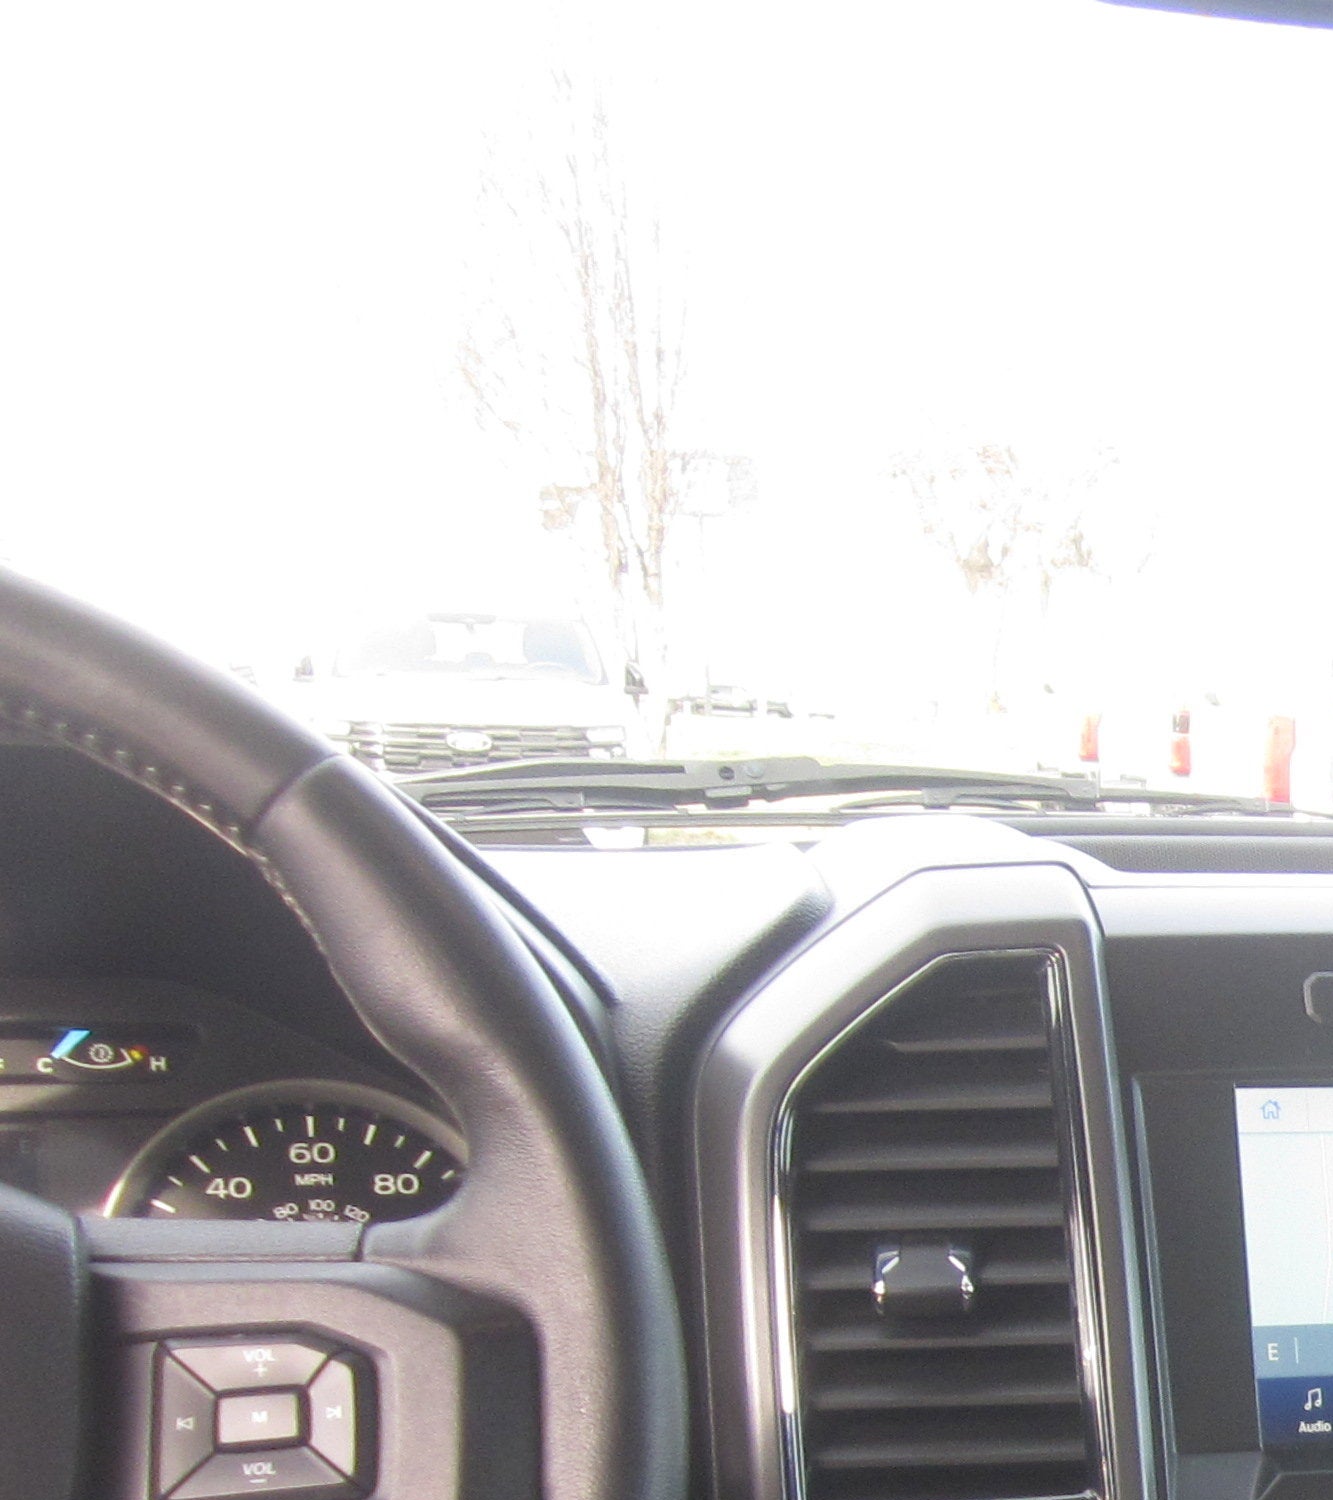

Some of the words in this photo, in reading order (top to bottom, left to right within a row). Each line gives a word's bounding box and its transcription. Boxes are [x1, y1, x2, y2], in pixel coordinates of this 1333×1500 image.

[36, 1057, 53, 1073] C
[150, 1056, 167, 1072] H
[289, 1142, 336, 1164] 60
[205, 1177, 251, 1199] 40
[294, 1174, 334, 1186] MPH
[373, 1173, 420, 1195] 80
[273, 1203, 299, 1219] 80
[308, 1199, 335, 1212] 100
[344, 1204, 370, 1223] 120
[242, 1348, 276, 1363] VOL
[1267, 1343, 1279, 1361] E
[1298, 1420, 1332, 1433] Audio
[242, 1461, 276, 1475] VOL
